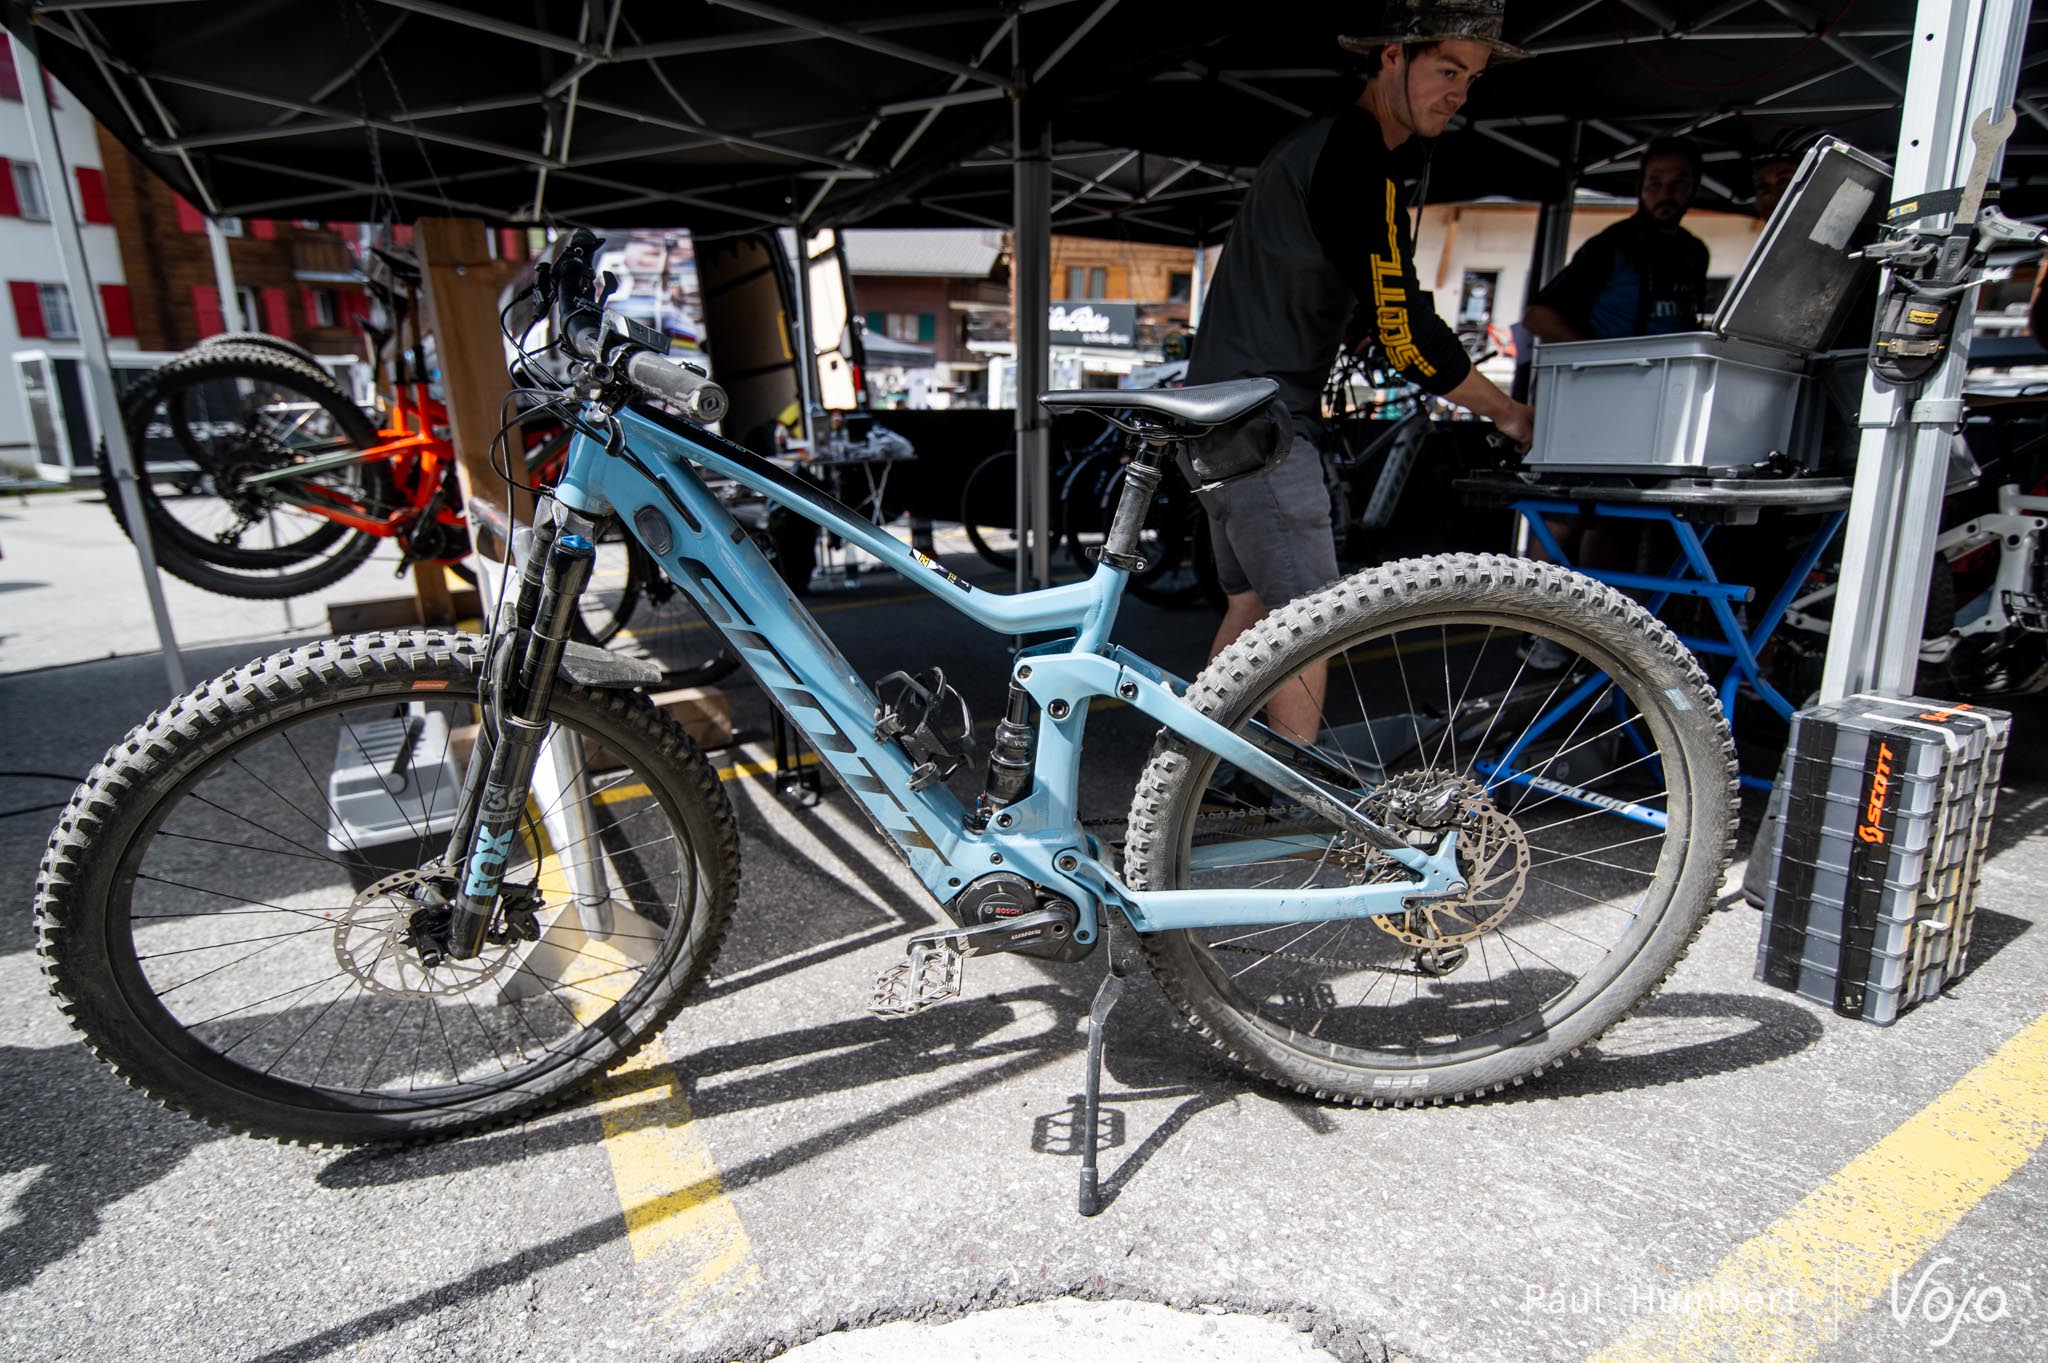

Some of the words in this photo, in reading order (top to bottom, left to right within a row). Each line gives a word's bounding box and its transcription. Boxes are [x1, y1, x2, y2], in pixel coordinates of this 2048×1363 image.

[1370, 253, 1437, 377] SCOTT
[153, 680, 403, 792] SCHWALBE
[678, 556, 953, 866] SCOTT
[486, 784, 525, 810] 36
[1867, 742, 1894, 827] SCOTT
[465, 824, 514, 896] FOX
[995, 907, 1021, 915] BOSCH
